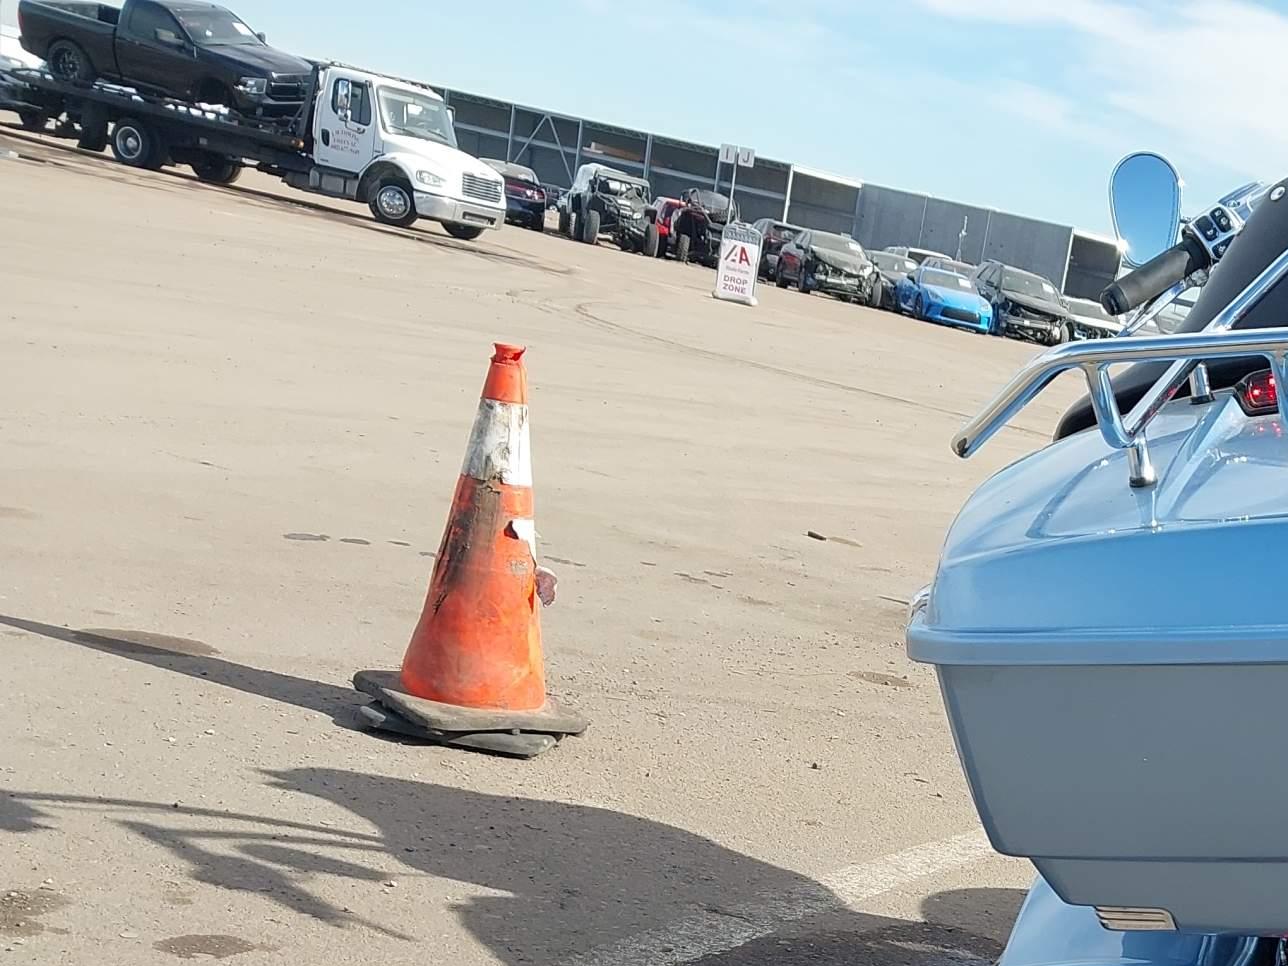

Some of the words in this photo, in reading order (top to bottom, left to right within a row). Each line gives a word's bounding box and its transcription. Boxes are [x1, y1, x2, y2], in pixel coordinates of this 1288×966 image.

[742, 151, 751, 163] J
[723, 274, 748, 285] DROP
[722, 283, 747, 294] ZONE
